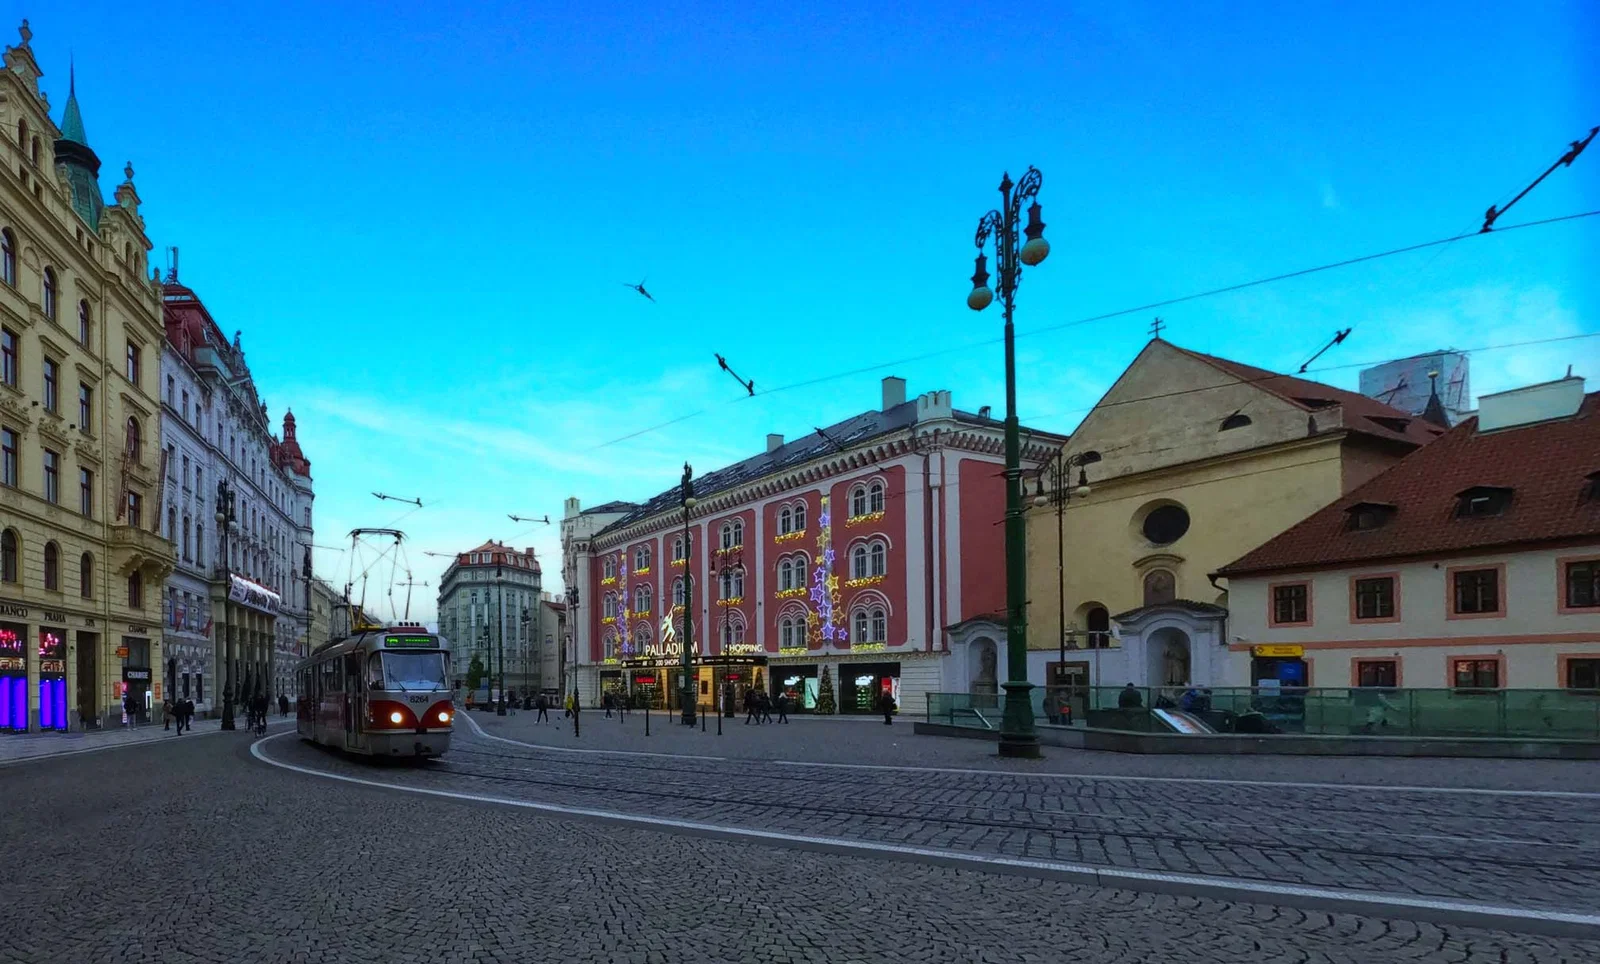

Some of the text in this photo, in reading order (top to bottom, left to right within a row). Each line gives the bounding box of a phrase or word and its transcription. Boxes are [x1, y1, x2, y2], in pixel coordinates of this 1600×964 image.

[44, 612, 66, 623] PRAHA
[655, 659, 664, 667] 200
[664, 658, 680, 667] SHOPS
[127, 671, 149, 680] CHANGE
[409, 694, 429, 704] 8264
